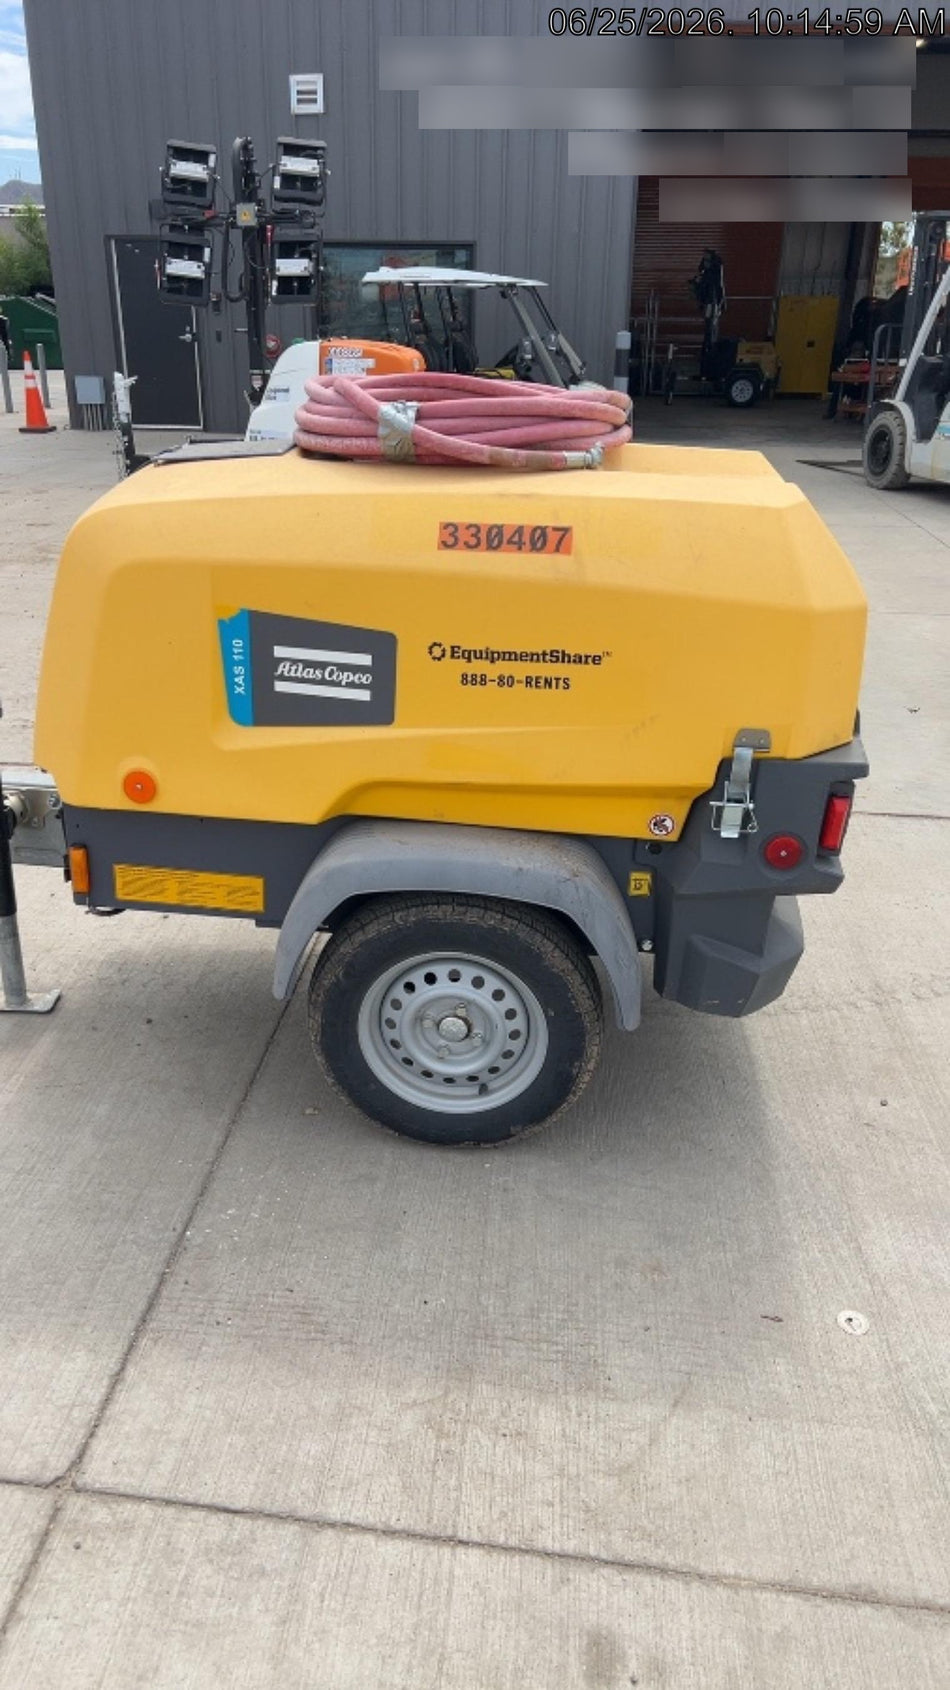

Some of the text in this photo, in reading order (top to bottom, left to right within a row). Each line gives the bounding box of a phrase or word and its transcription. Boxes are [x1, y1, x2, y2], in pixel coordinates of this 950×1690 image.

[440, 522, 571, 553] 330407
[232, 639, 246, 695] XAS 110
[274, 661, 372, 685] Atlas Copco
[460, 672, 571, 690] 888-80-RENTS
